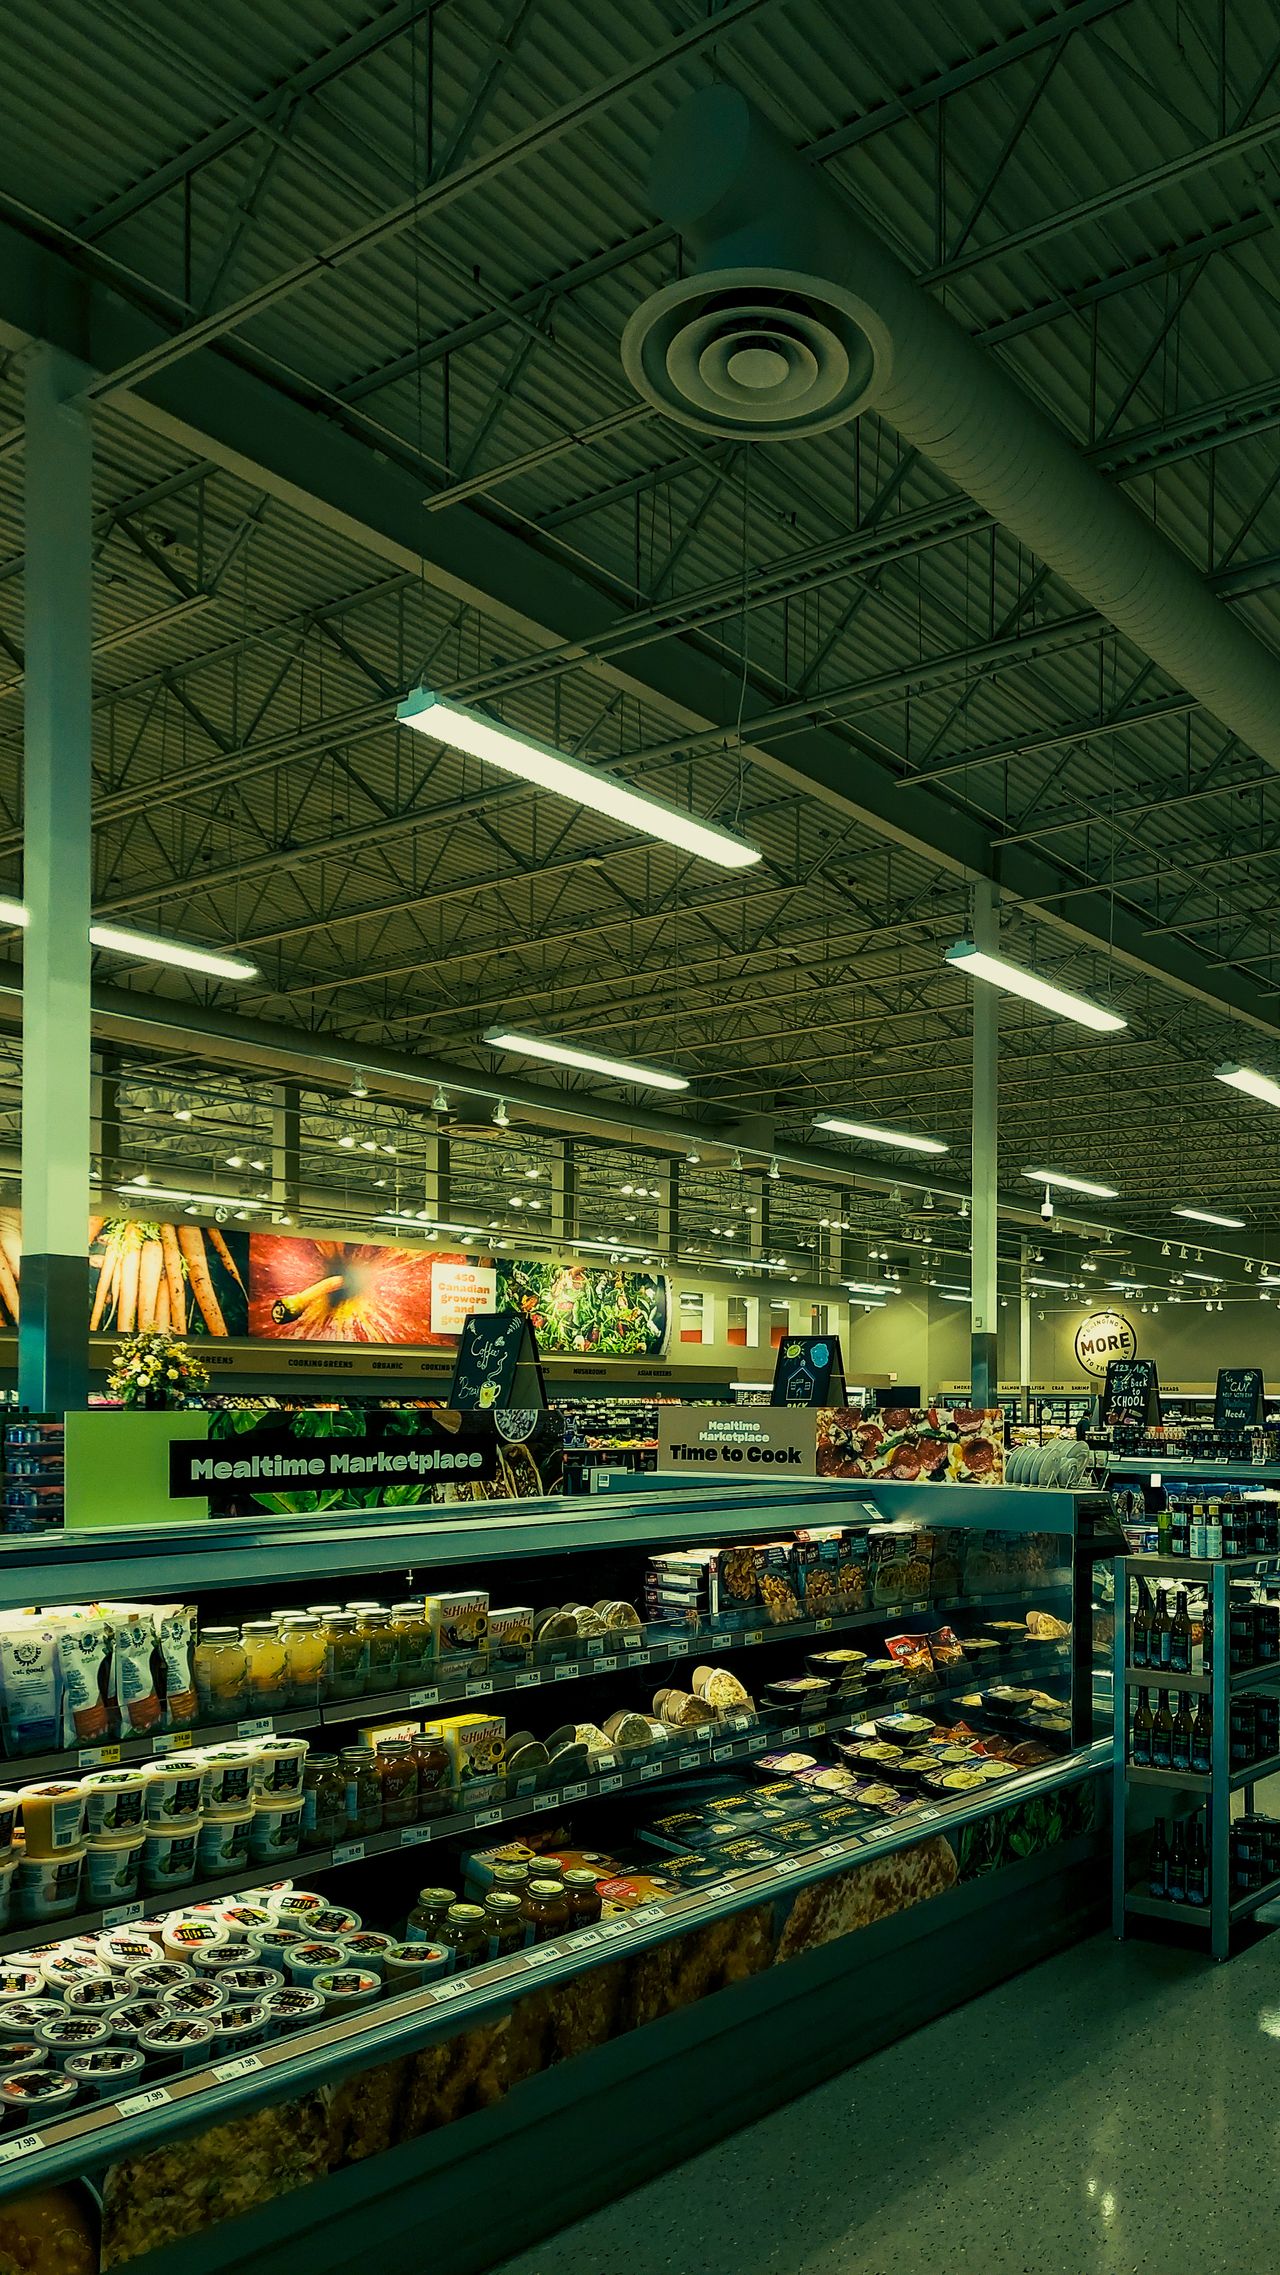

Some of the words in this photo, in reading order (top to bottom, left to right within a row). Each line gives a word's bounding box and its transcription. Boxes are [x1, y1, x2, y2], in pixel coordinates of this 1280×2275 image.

[438, 1282, 490, 1294] Canadian
[441, 1294, 487, 1304] growers
[454, 1305, 474, 1313] and
[1080, 1332, 1131, 1356] MORE
[471, 1335, 500, 1370] Coffee
[200, 1356, 233, 1364] GREENS
[288, 1359, 323, 1367] COOKING
[323, 1361, 353, 1369] GREENS
[372, 1361, 403, 1369] ORGANIC
[1111, 1396, 1146, 1408] SCHOOL
[708, 1421, 761, 1431] Mealtime
[699, 1432, 770, 1443] Marketplace
[670, 1443, 718, 1462] Time
[721, 1445, 744, 1462] to
[747, 1446, 803, 1464] Cook
[191, 1455, 325, 1480] Mealtime
[330, 1449, 483, 1475] Marketplace
[126, 1904, 141, 1916] 7.99
[450, 1982, 467, 1993] 7.99
[238, 2057, 257, 2070] 7.99
[144, 2090, 165, 2104] 7.99
[15, 2136, 37, 2151] 7.99
